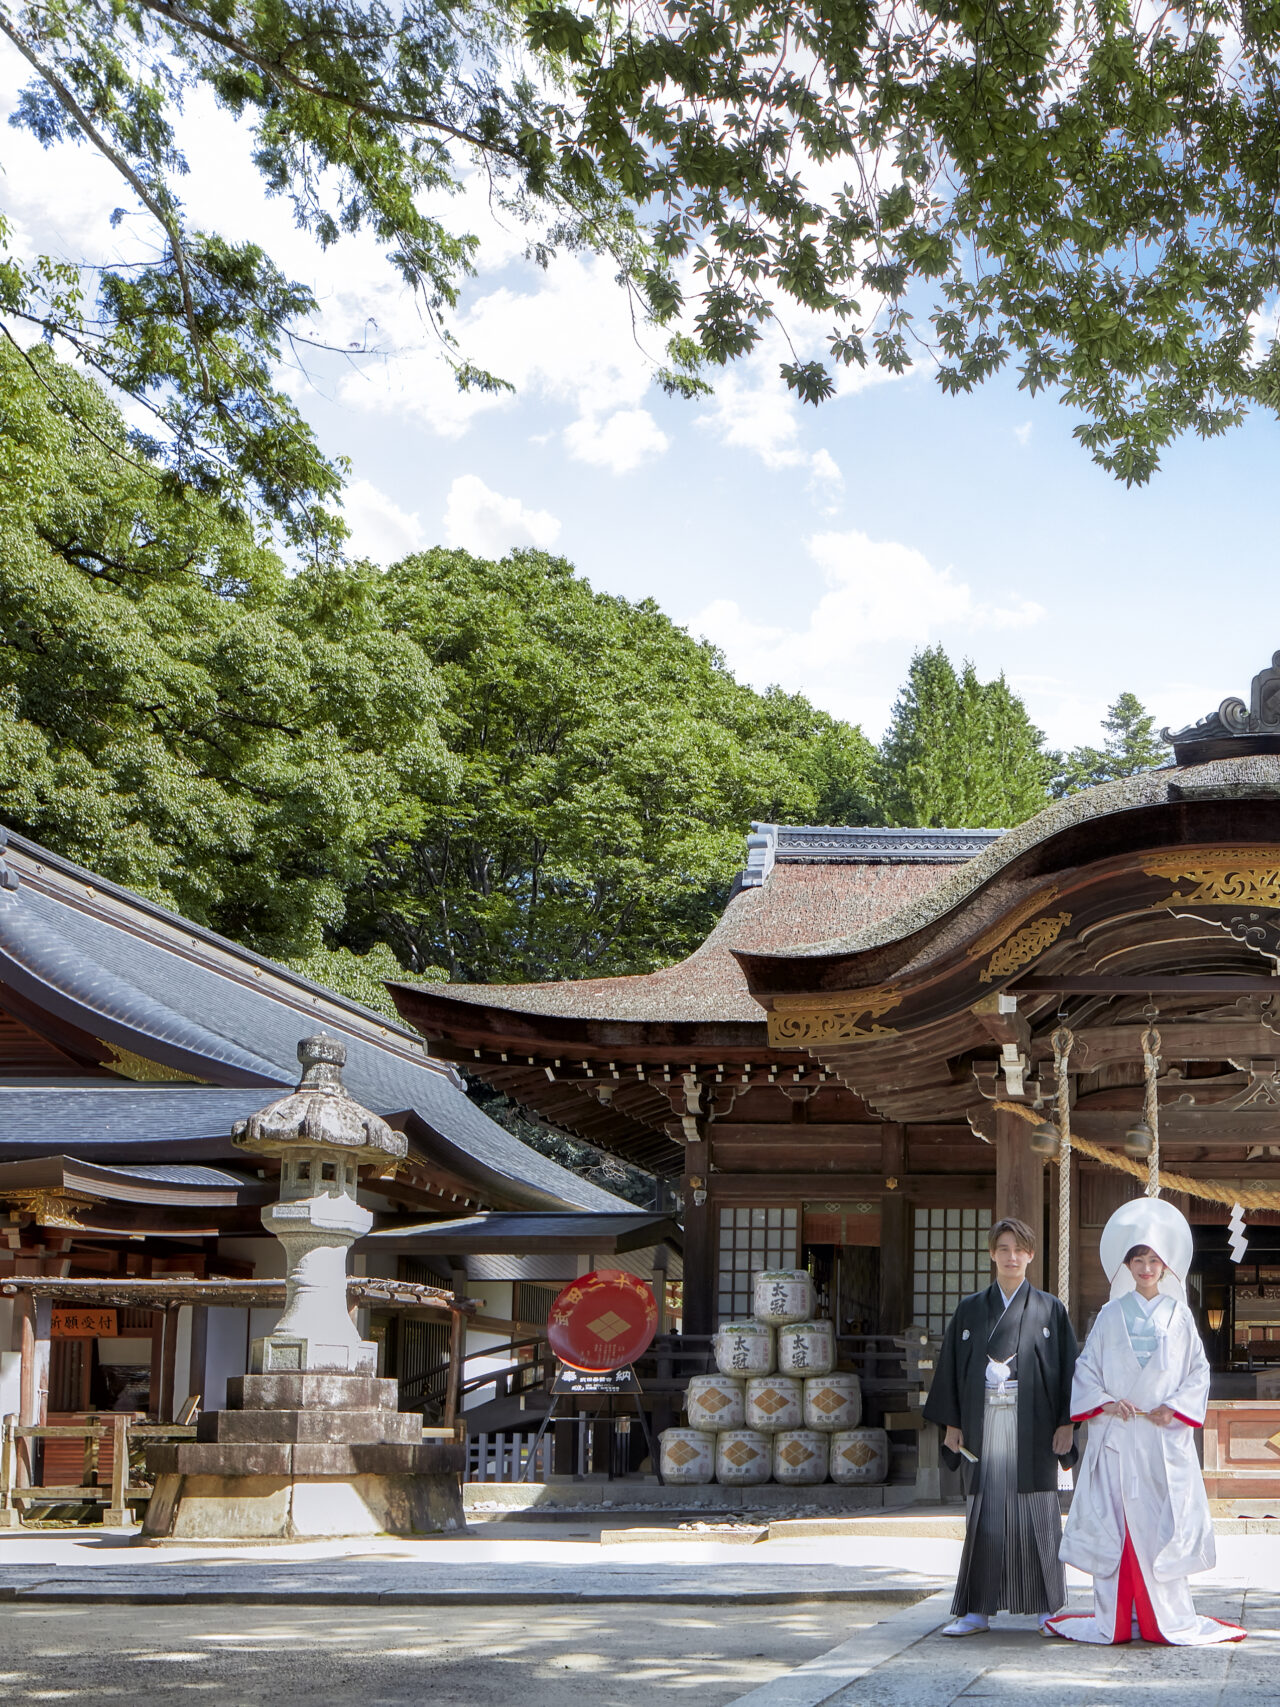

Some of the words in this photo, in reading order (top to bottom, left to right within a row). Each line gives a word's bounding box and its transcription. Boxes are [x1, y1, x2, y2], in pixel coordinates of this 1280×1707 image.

[770, 1282, 789, 1315] 太冠
[732, 1335, 750, 1369] 太冠
[792, 1334, 809, 1368] 太冠
